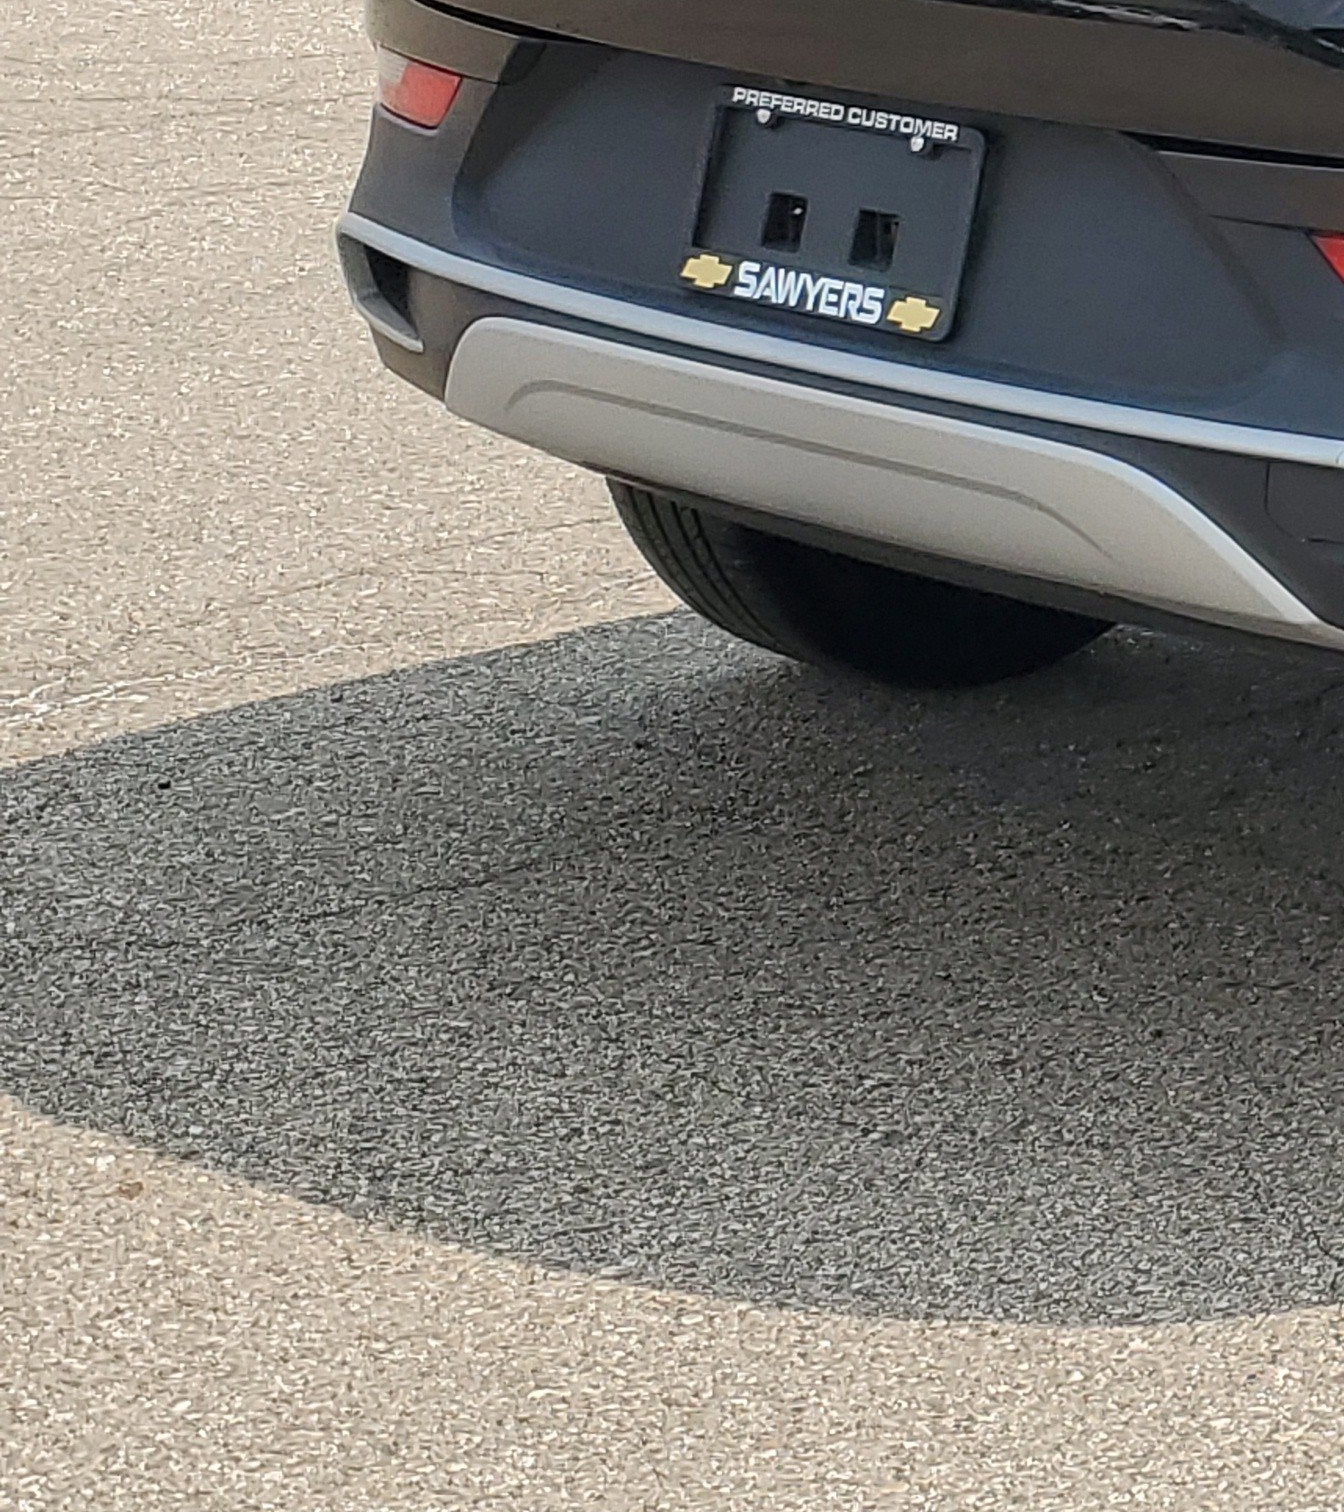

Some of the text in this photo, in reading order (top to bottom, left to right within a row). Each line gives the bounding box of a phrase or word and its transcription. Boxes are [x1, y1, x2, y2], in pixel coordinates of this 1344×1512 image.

[732, 86, 959, 142] PREFERRED CUSTOMER
[734, 260, 885, 325] SAWYERS
